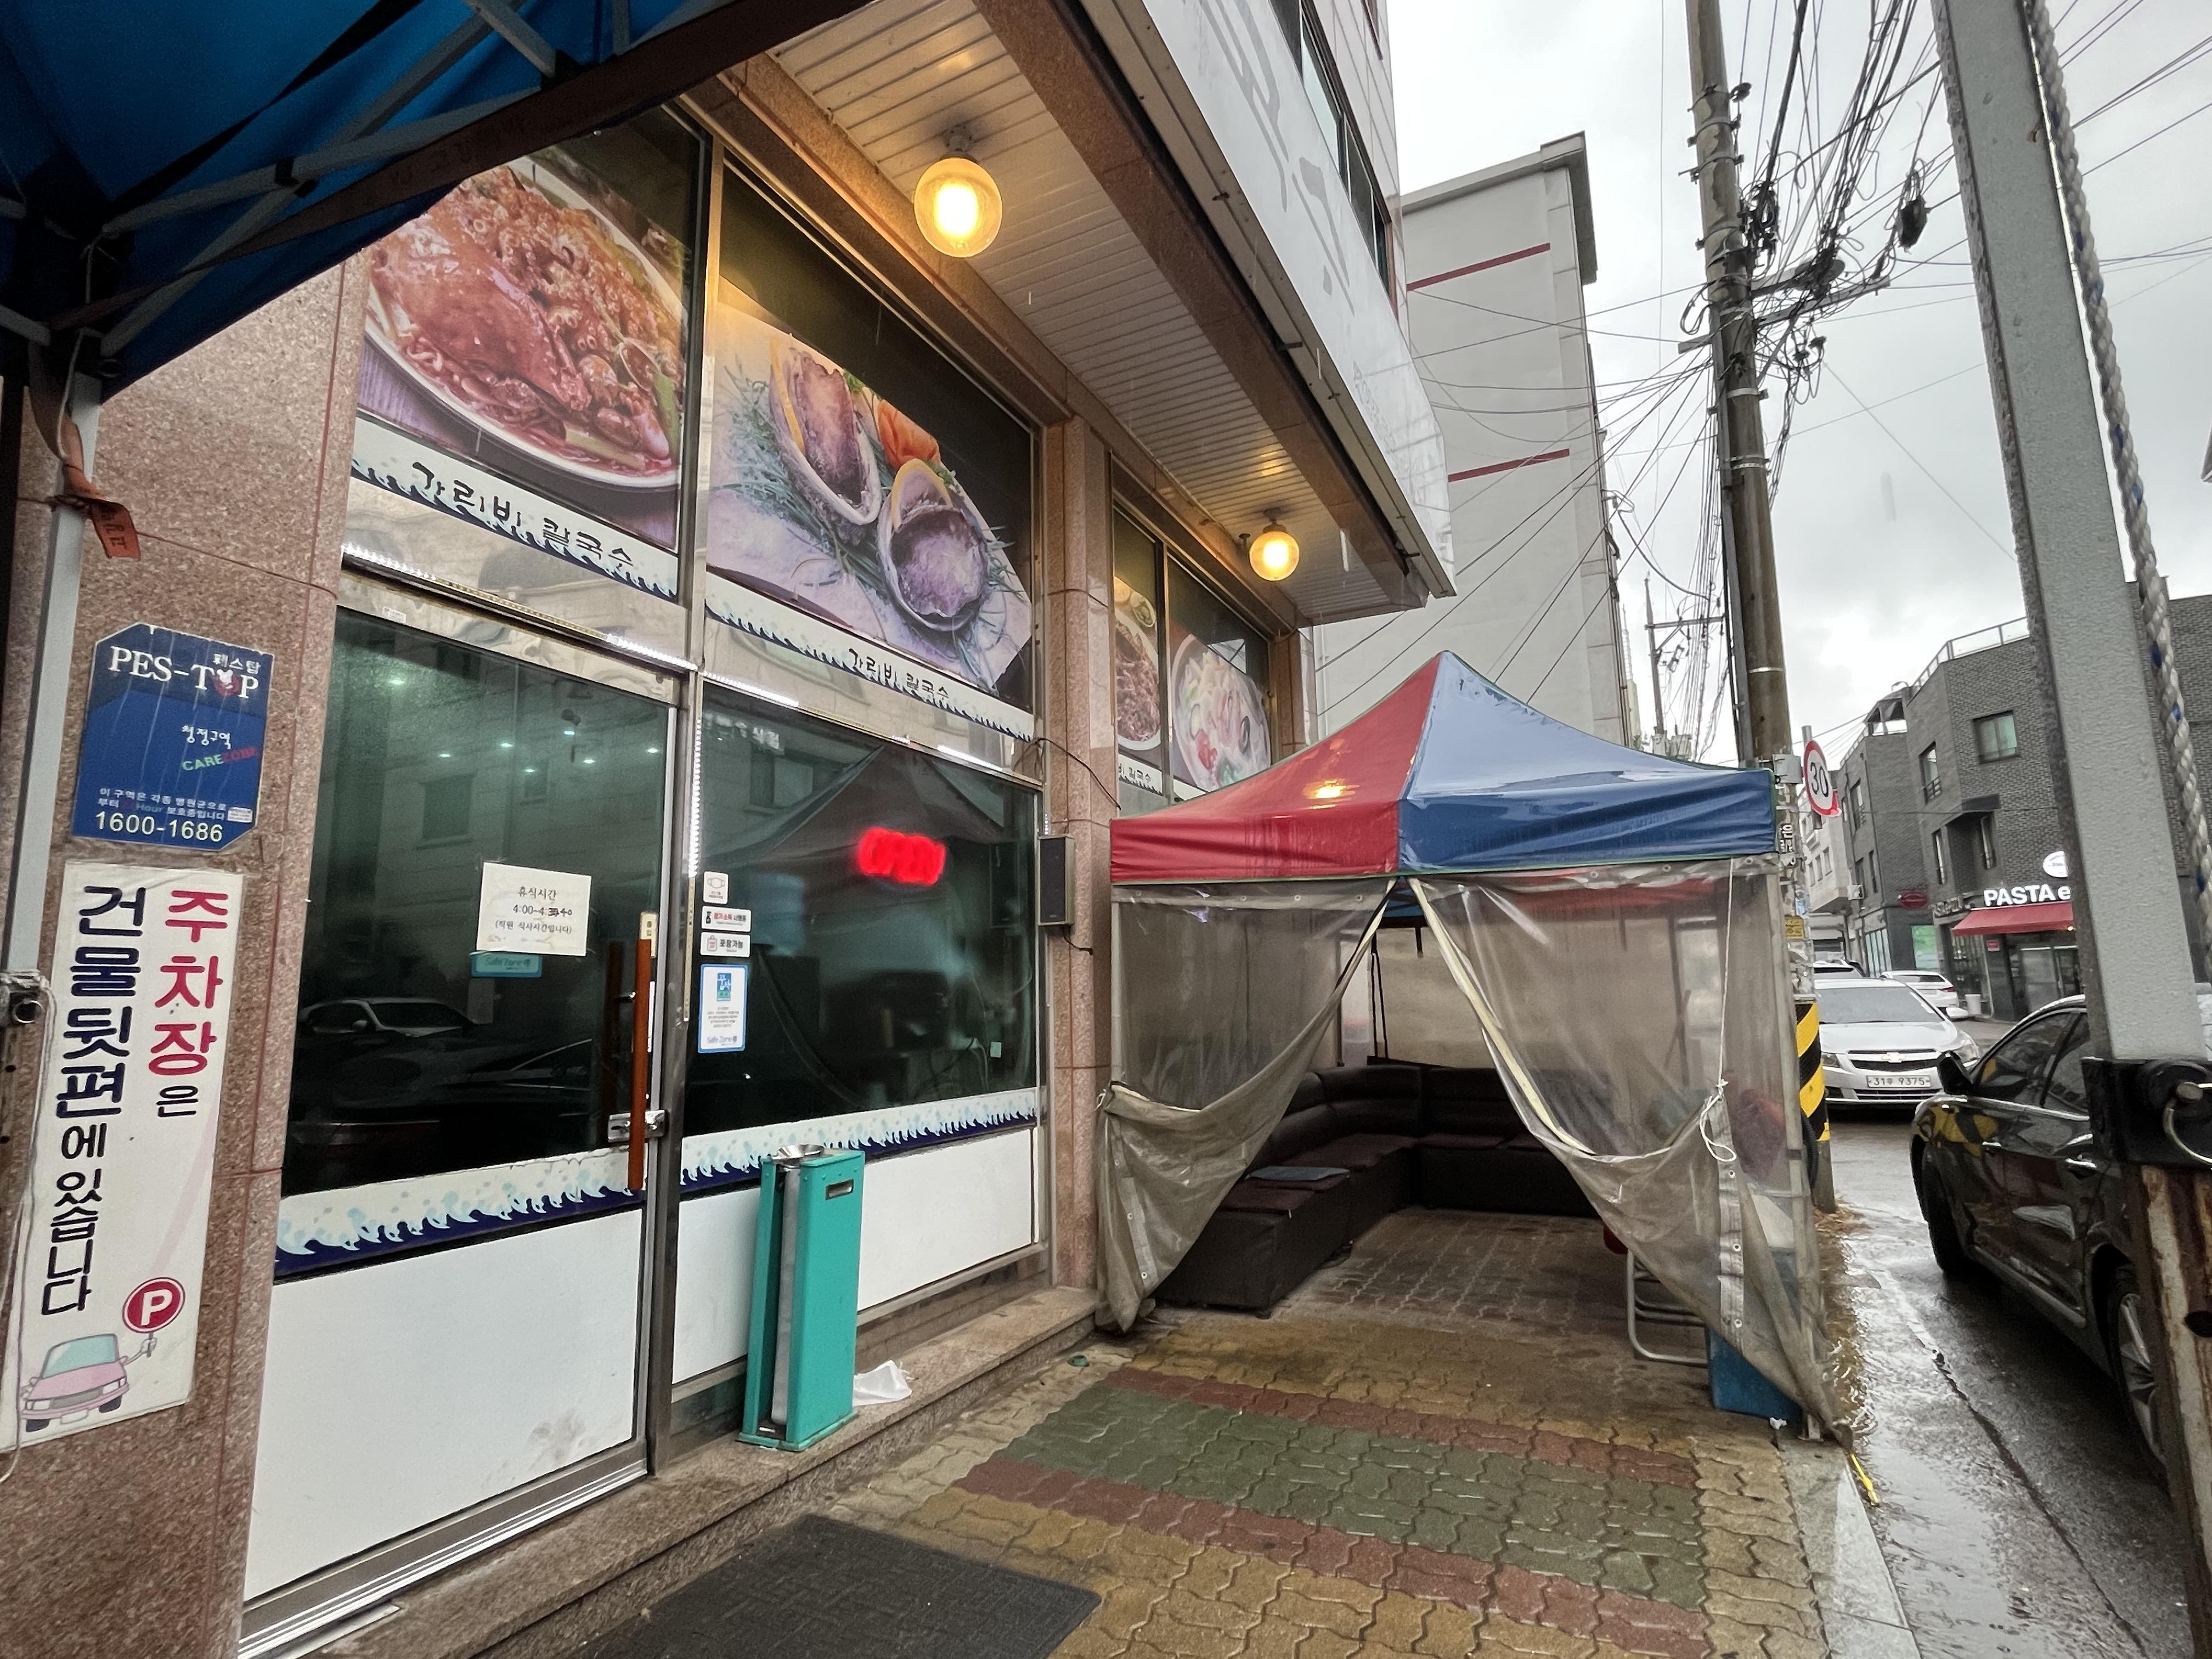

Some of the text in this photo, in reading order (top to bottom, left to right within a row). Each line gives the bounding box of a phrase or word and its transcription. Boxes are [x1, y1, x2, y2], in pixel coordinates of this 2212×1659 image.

[413, 461, 634, 567] 가리비 칼국수
[849, 648, 898, 683] 가리비
[1810, 761, 1829, 798] 30
[95, 811, 223, 842] 1600-1686
[517, 886, 557, 901] 휴식시간
[1983, 884, 2056, 906] PASTA
[1898, 1077, 1925, 1086] 9375
[140, 1288, 172, 1325] P
